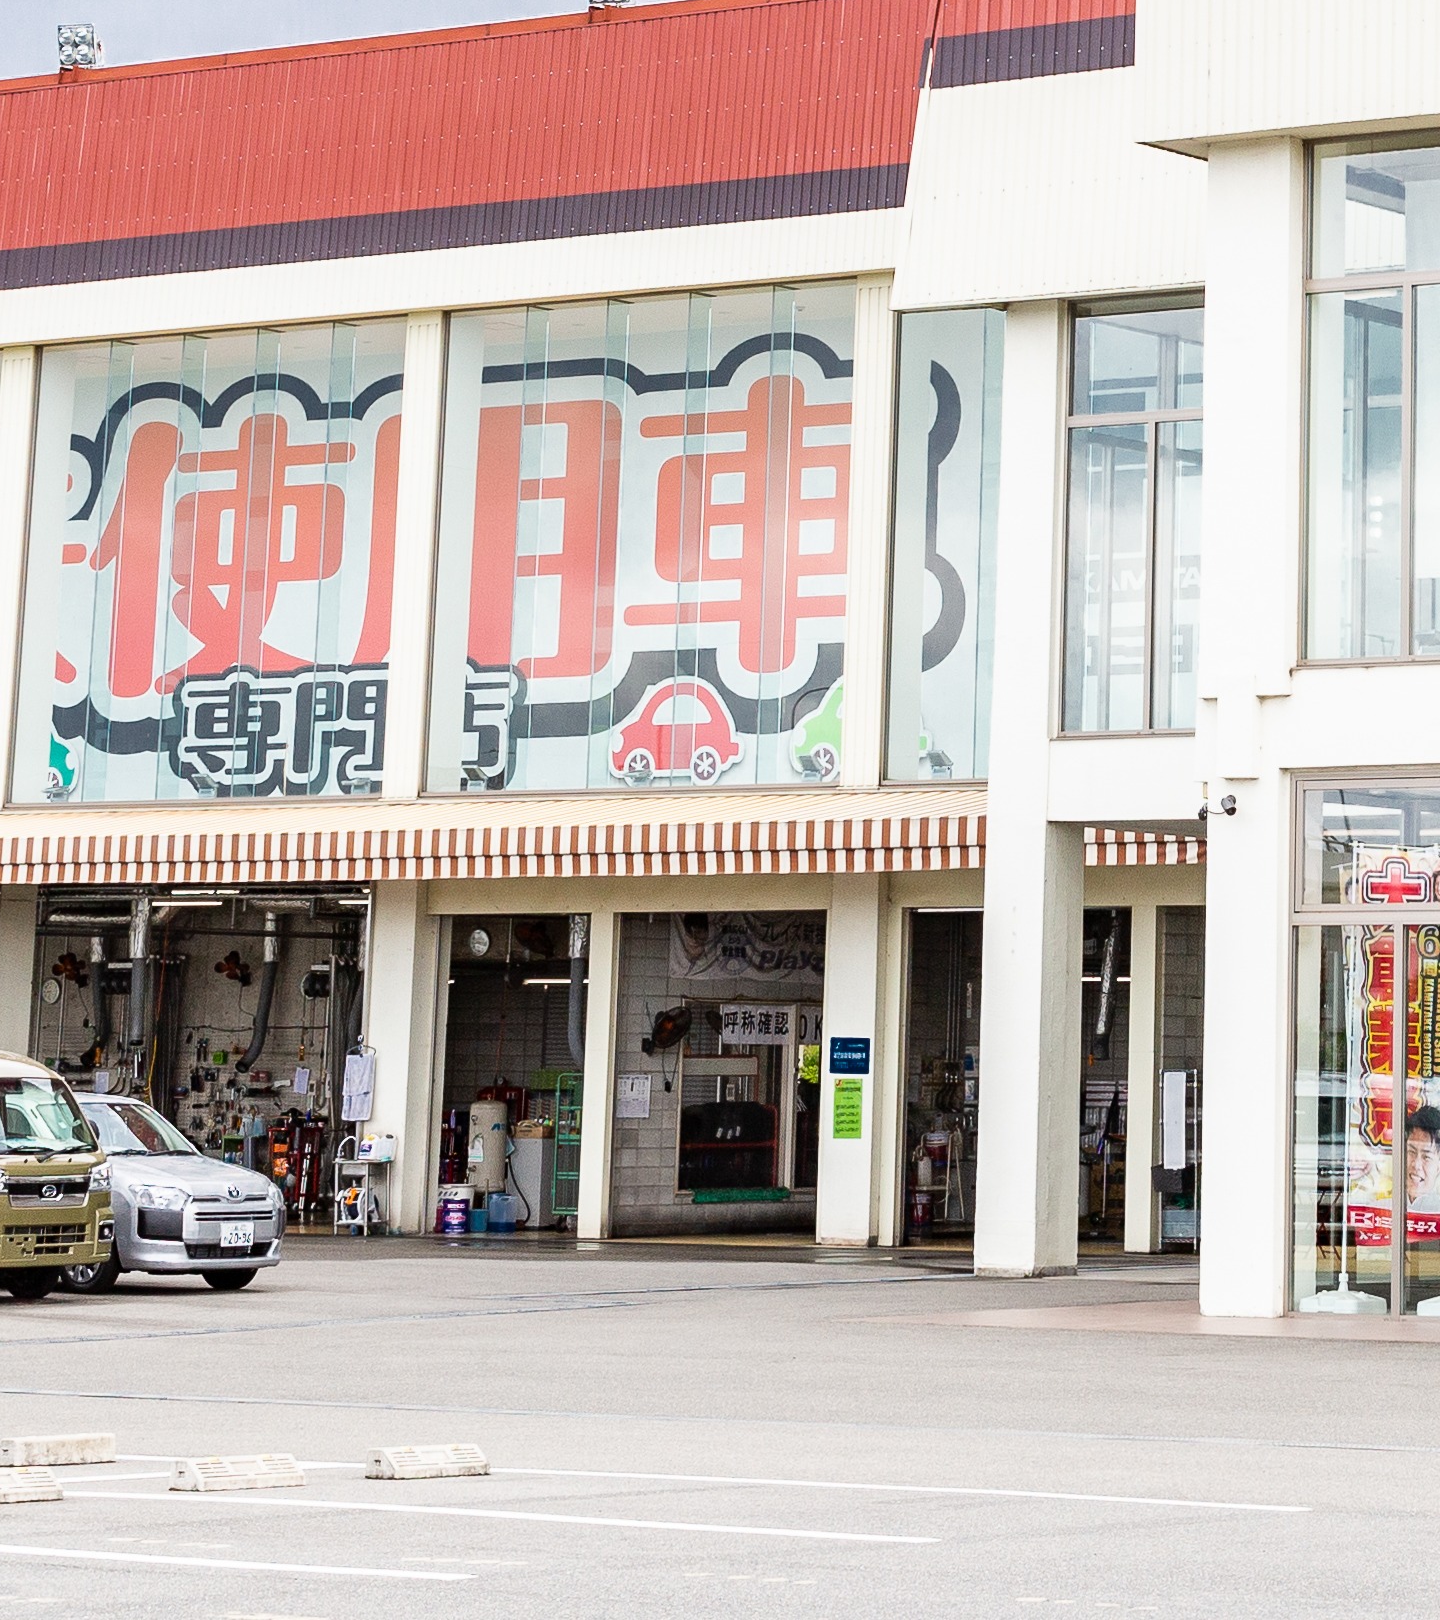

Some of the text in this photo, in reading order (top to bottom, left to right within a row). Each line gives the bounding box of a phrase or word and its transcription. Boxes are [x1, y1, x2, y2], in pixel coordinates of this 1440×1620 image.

[724, 1011, 789, 1035] 呼称確認
[1375, 1216, 1437, 1233] カミモータース
